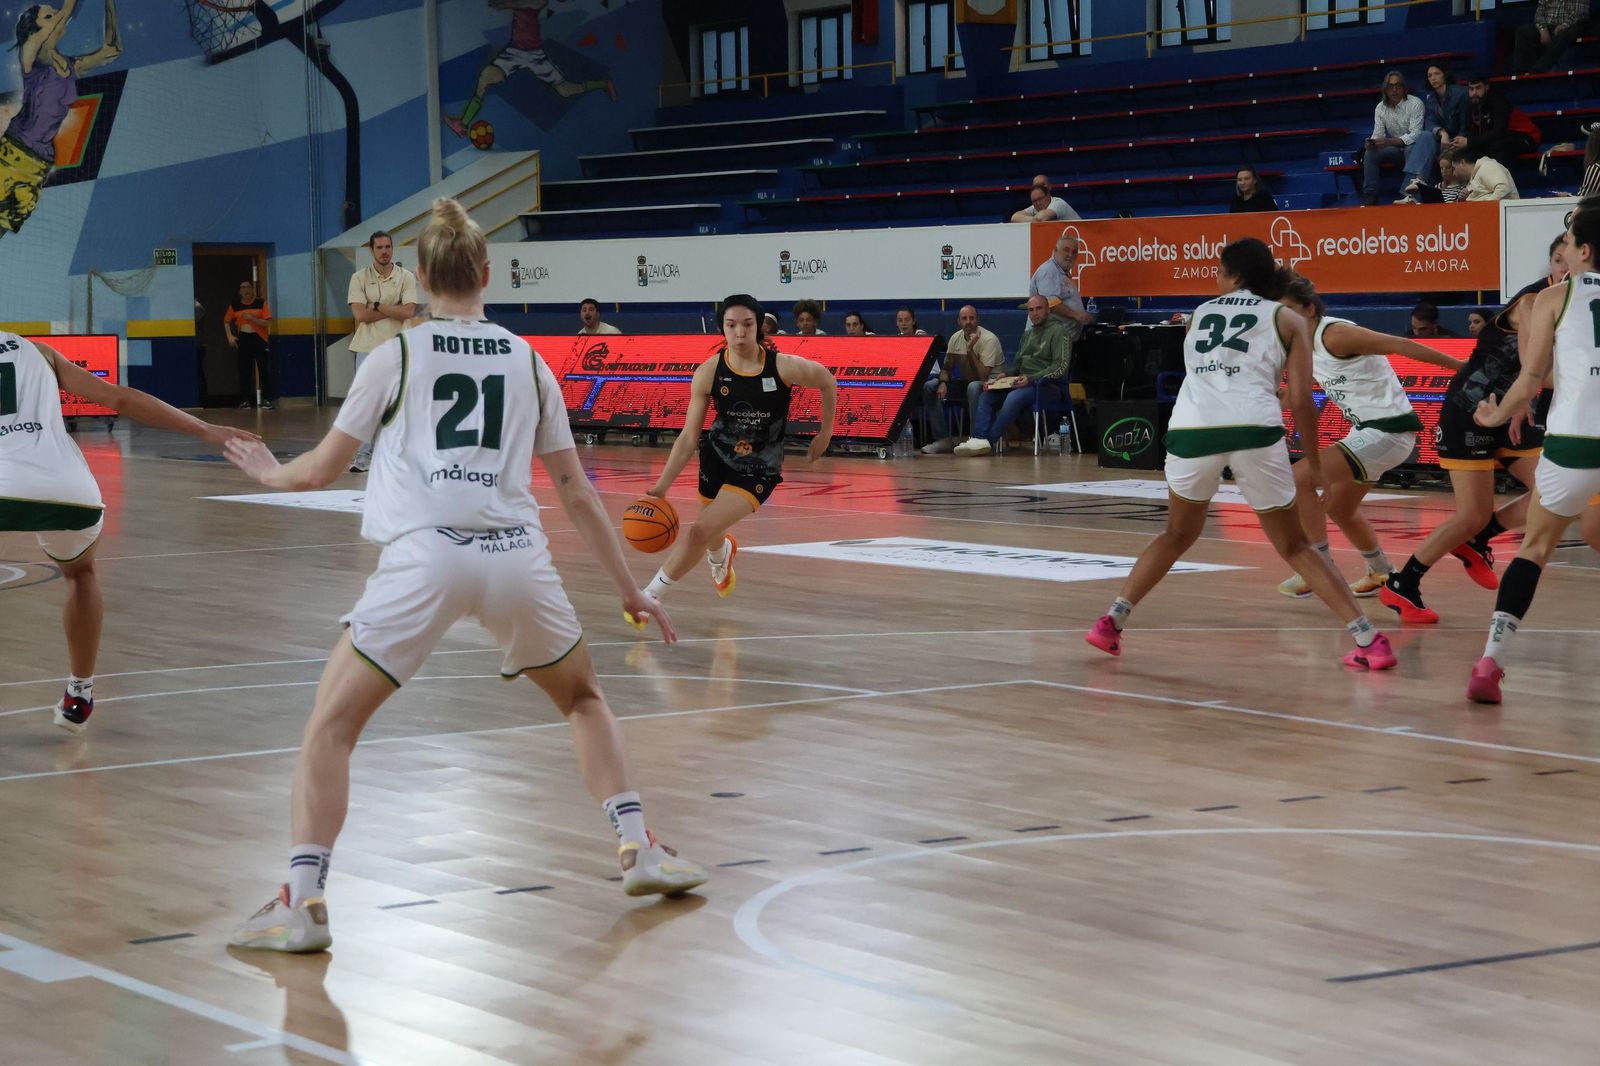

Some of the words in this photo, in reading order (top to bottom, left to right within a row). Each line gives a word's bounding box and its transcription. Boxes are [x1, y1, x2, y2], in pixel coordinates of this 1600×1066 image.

[1316, 227, 1408, 256] recoletas
[1416, 224, 1469, 253] salud
[1100, 236, 1177, 263] recoletas
[1183, 234, 1227, 261] salud
[792, 258, 828, 274] ZAMORA
[955, 254, 997, 270] ZAMORA
[1404, 259, 1470, 273] ZAMORA
[521, 266, 550, 280] ZAMORA
[648, 263, 680, 278] ZAMORA
[1173, 266, 1218, 279] ZAMOR
[1195, 313, 1258, 354] 32
[432, 334, 512, 356] ROTERS
[432, 373, 505, 450] 21
[726, 410, 771, 418] recoletas
[504, 526, 530, 540] SOL
[480, 538, 534, 553] MÁLAGA
